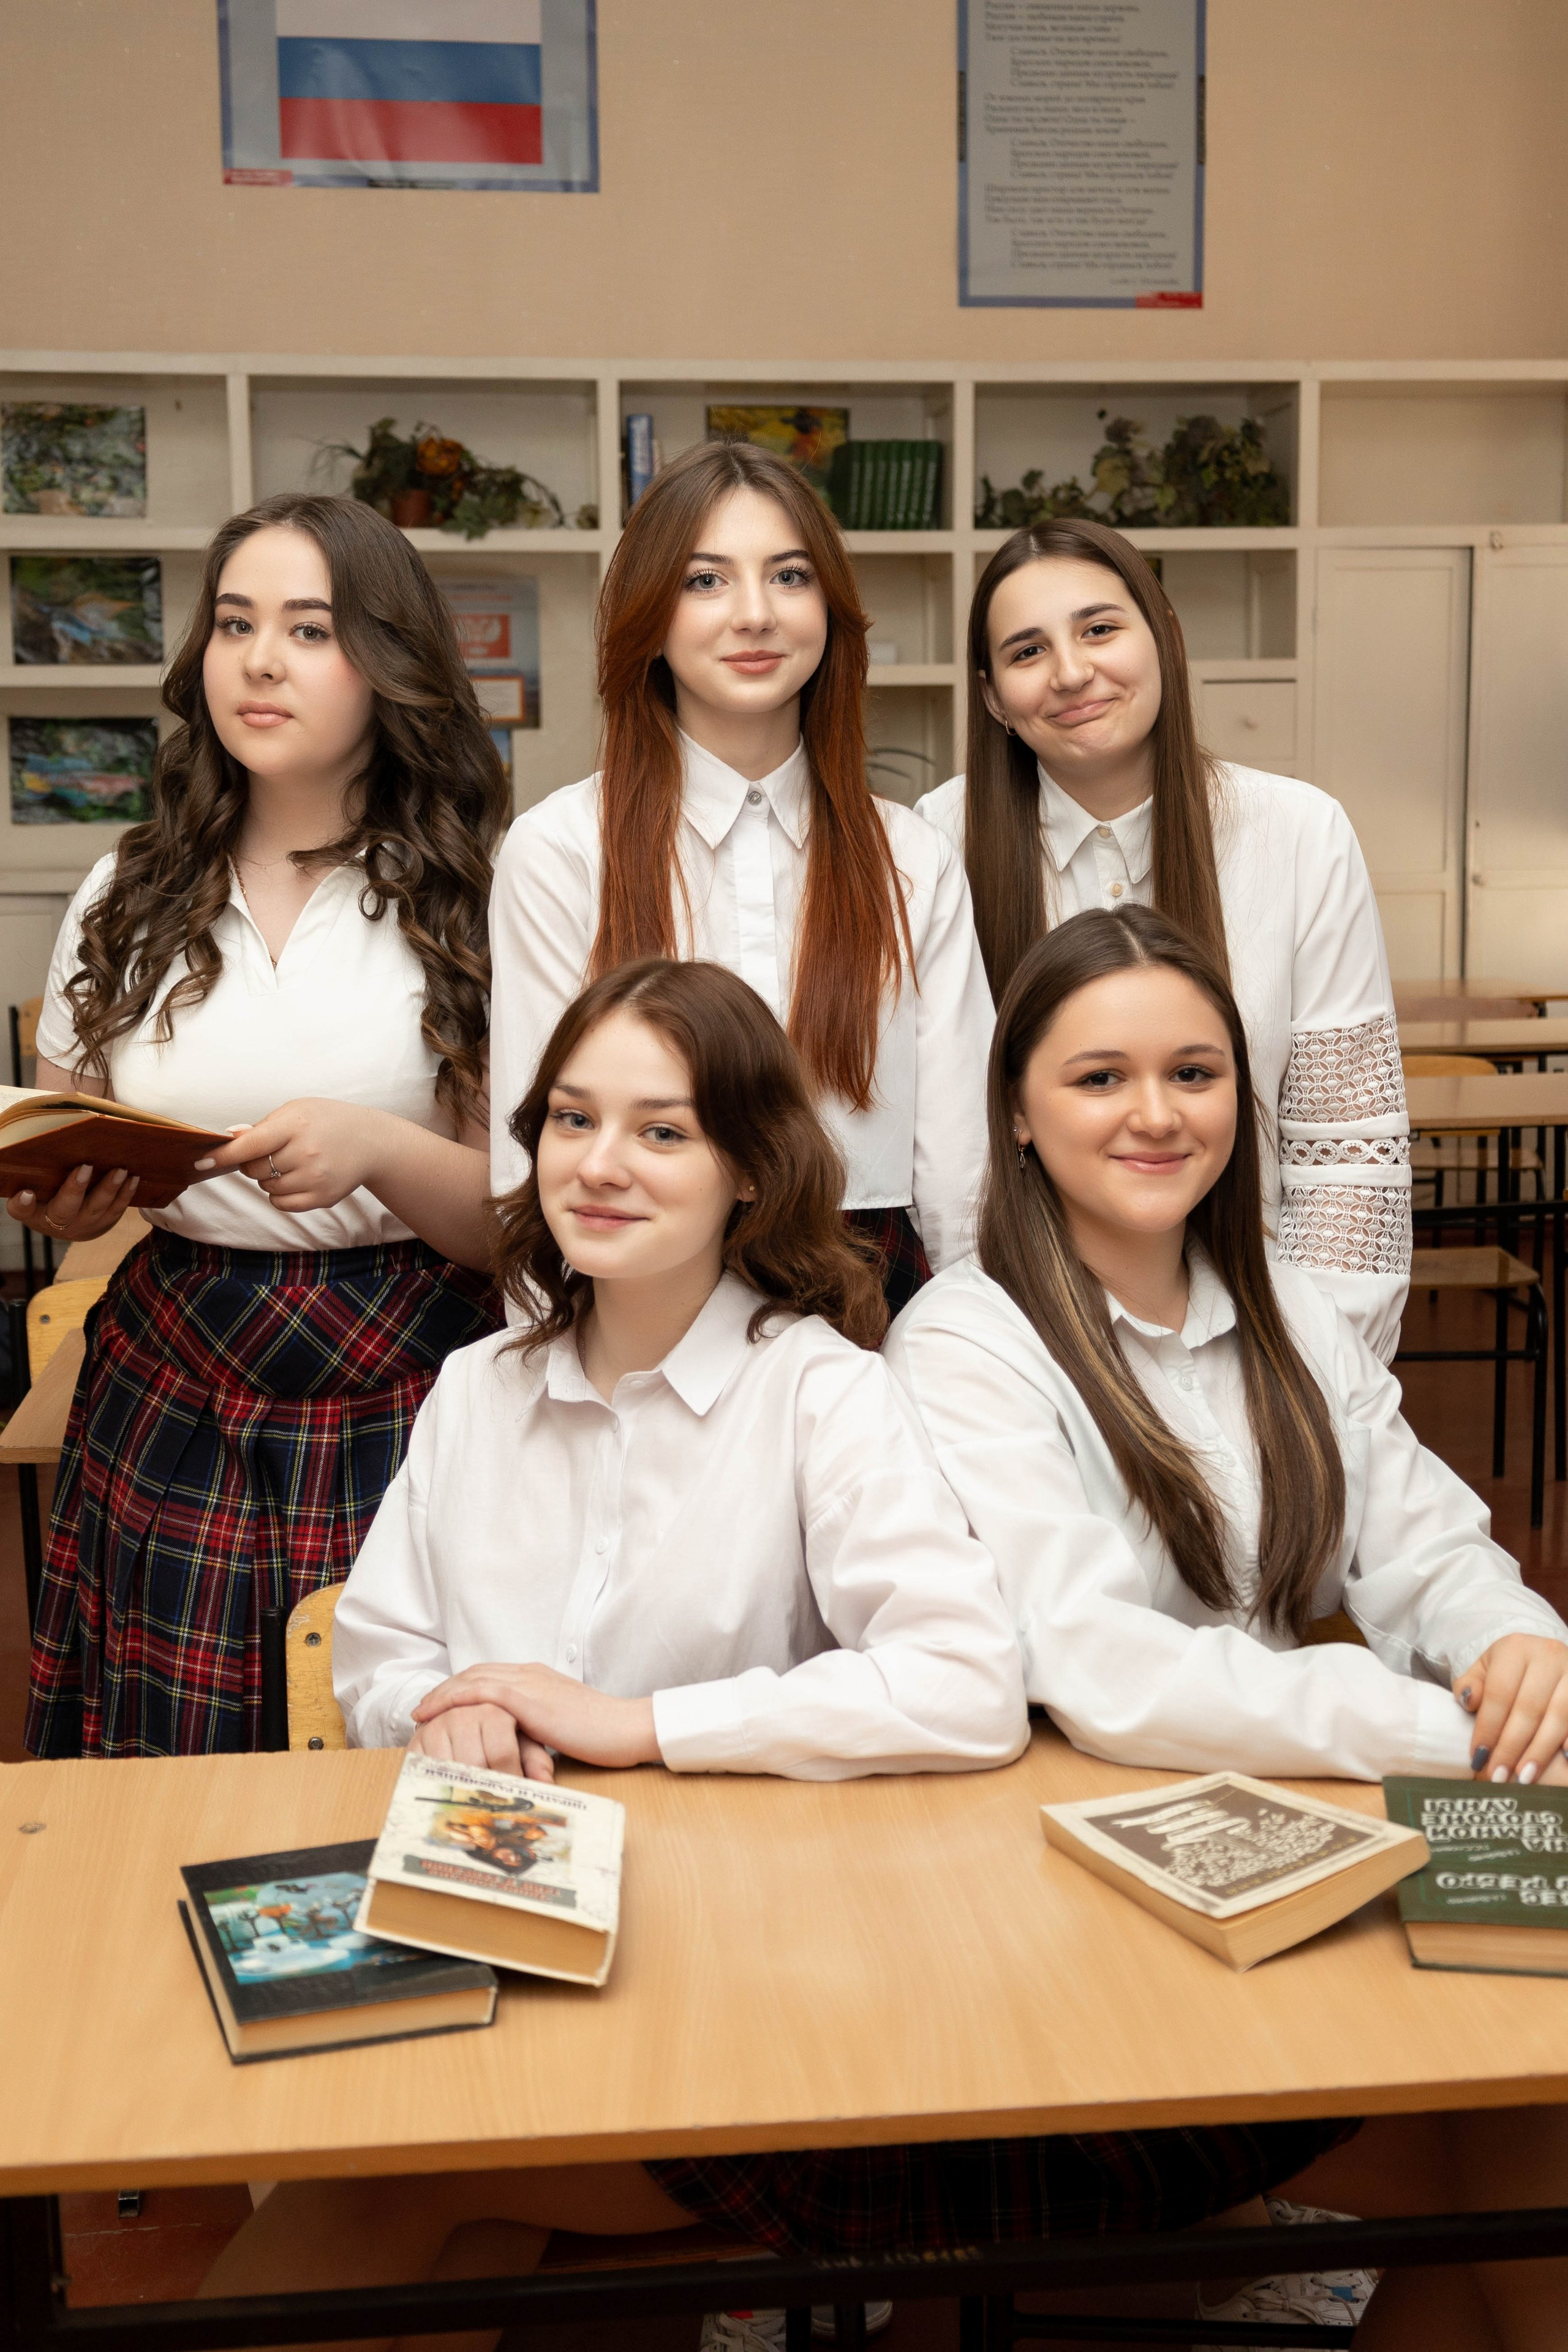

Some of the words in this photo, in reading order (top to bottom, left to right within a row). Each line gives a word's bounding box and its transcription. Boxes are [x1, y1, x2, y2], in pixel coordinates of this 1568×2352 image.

[1425, 1798, 1517, 1812] ЛУНЫ
[1422, 1812, 1562, 1826] СТОРОНЕ
[1427, 1825, 1566, 1842] ТЕМНОЙ
[1436, 1872, 1549, 1890] РЕБРО
[1520, 1889, 1568, 1906] ЕС
